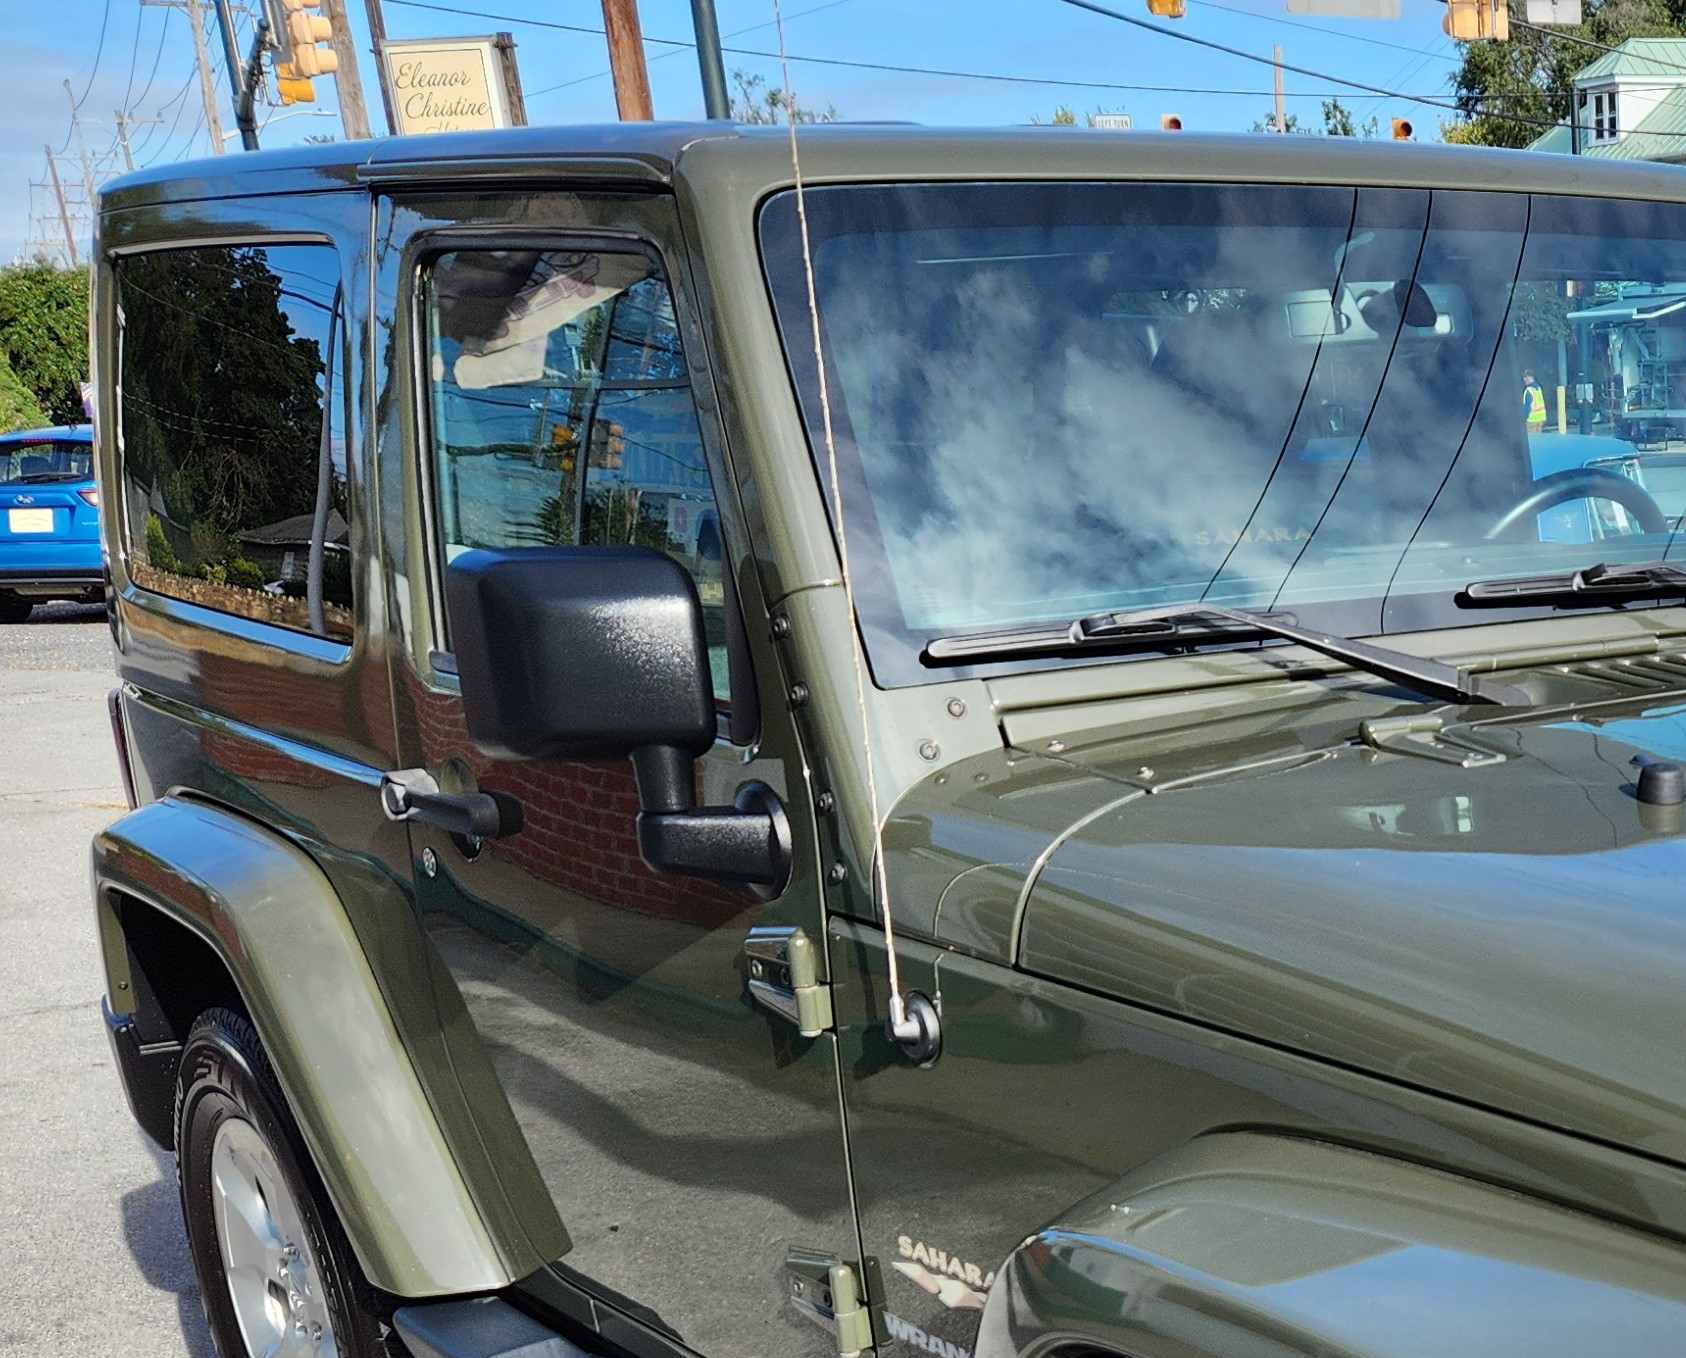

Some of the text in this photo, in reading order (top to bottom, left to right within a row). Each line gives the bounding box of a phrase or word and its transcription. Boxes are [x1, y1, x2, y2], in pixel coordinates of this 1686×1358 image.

[395, 61, 471, 89] Eleanor
[405, 92, 490, 119] Christine
[1195, 526, 1315, 545] SAHARA
